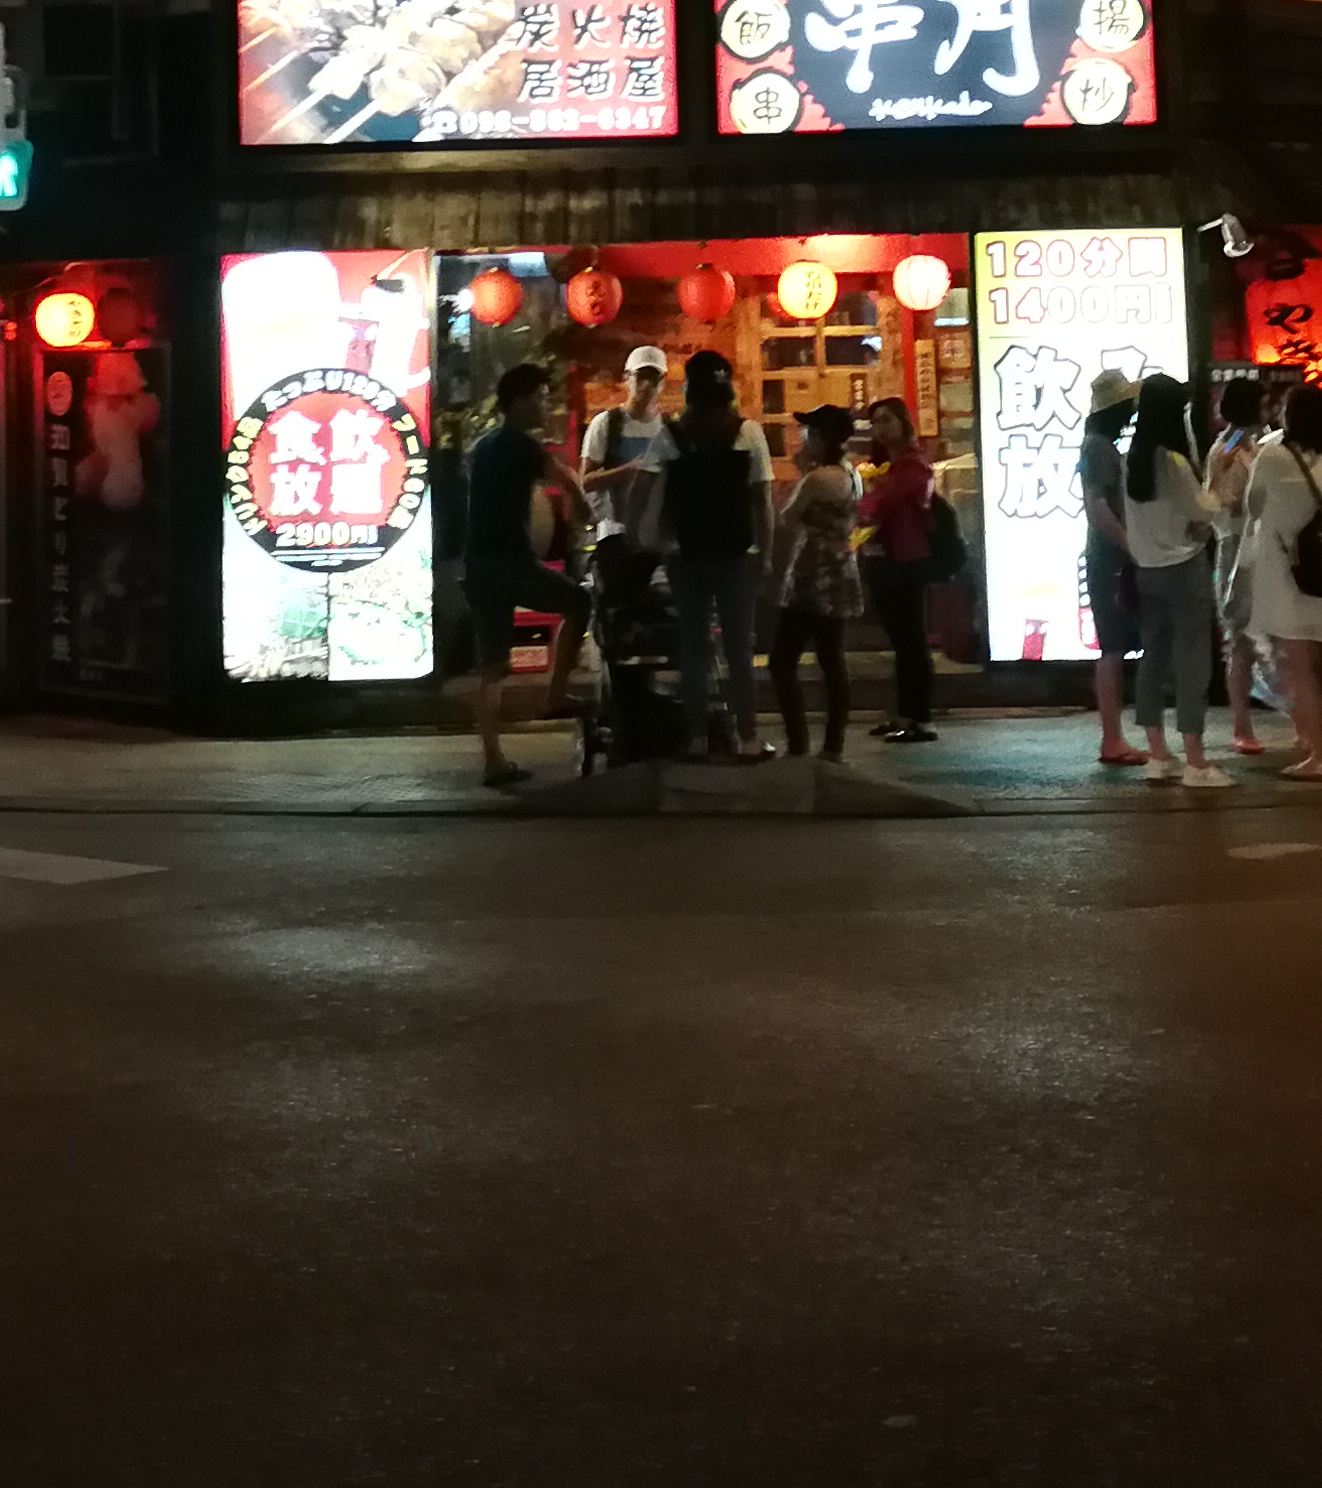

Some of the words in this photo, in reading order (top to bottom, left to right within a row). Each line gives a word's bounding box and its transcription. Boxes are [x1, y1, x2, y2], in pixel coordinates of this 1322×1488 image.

[516, 56, 666, 104] 居酒屋
[753, 86, 783, 123] 串
